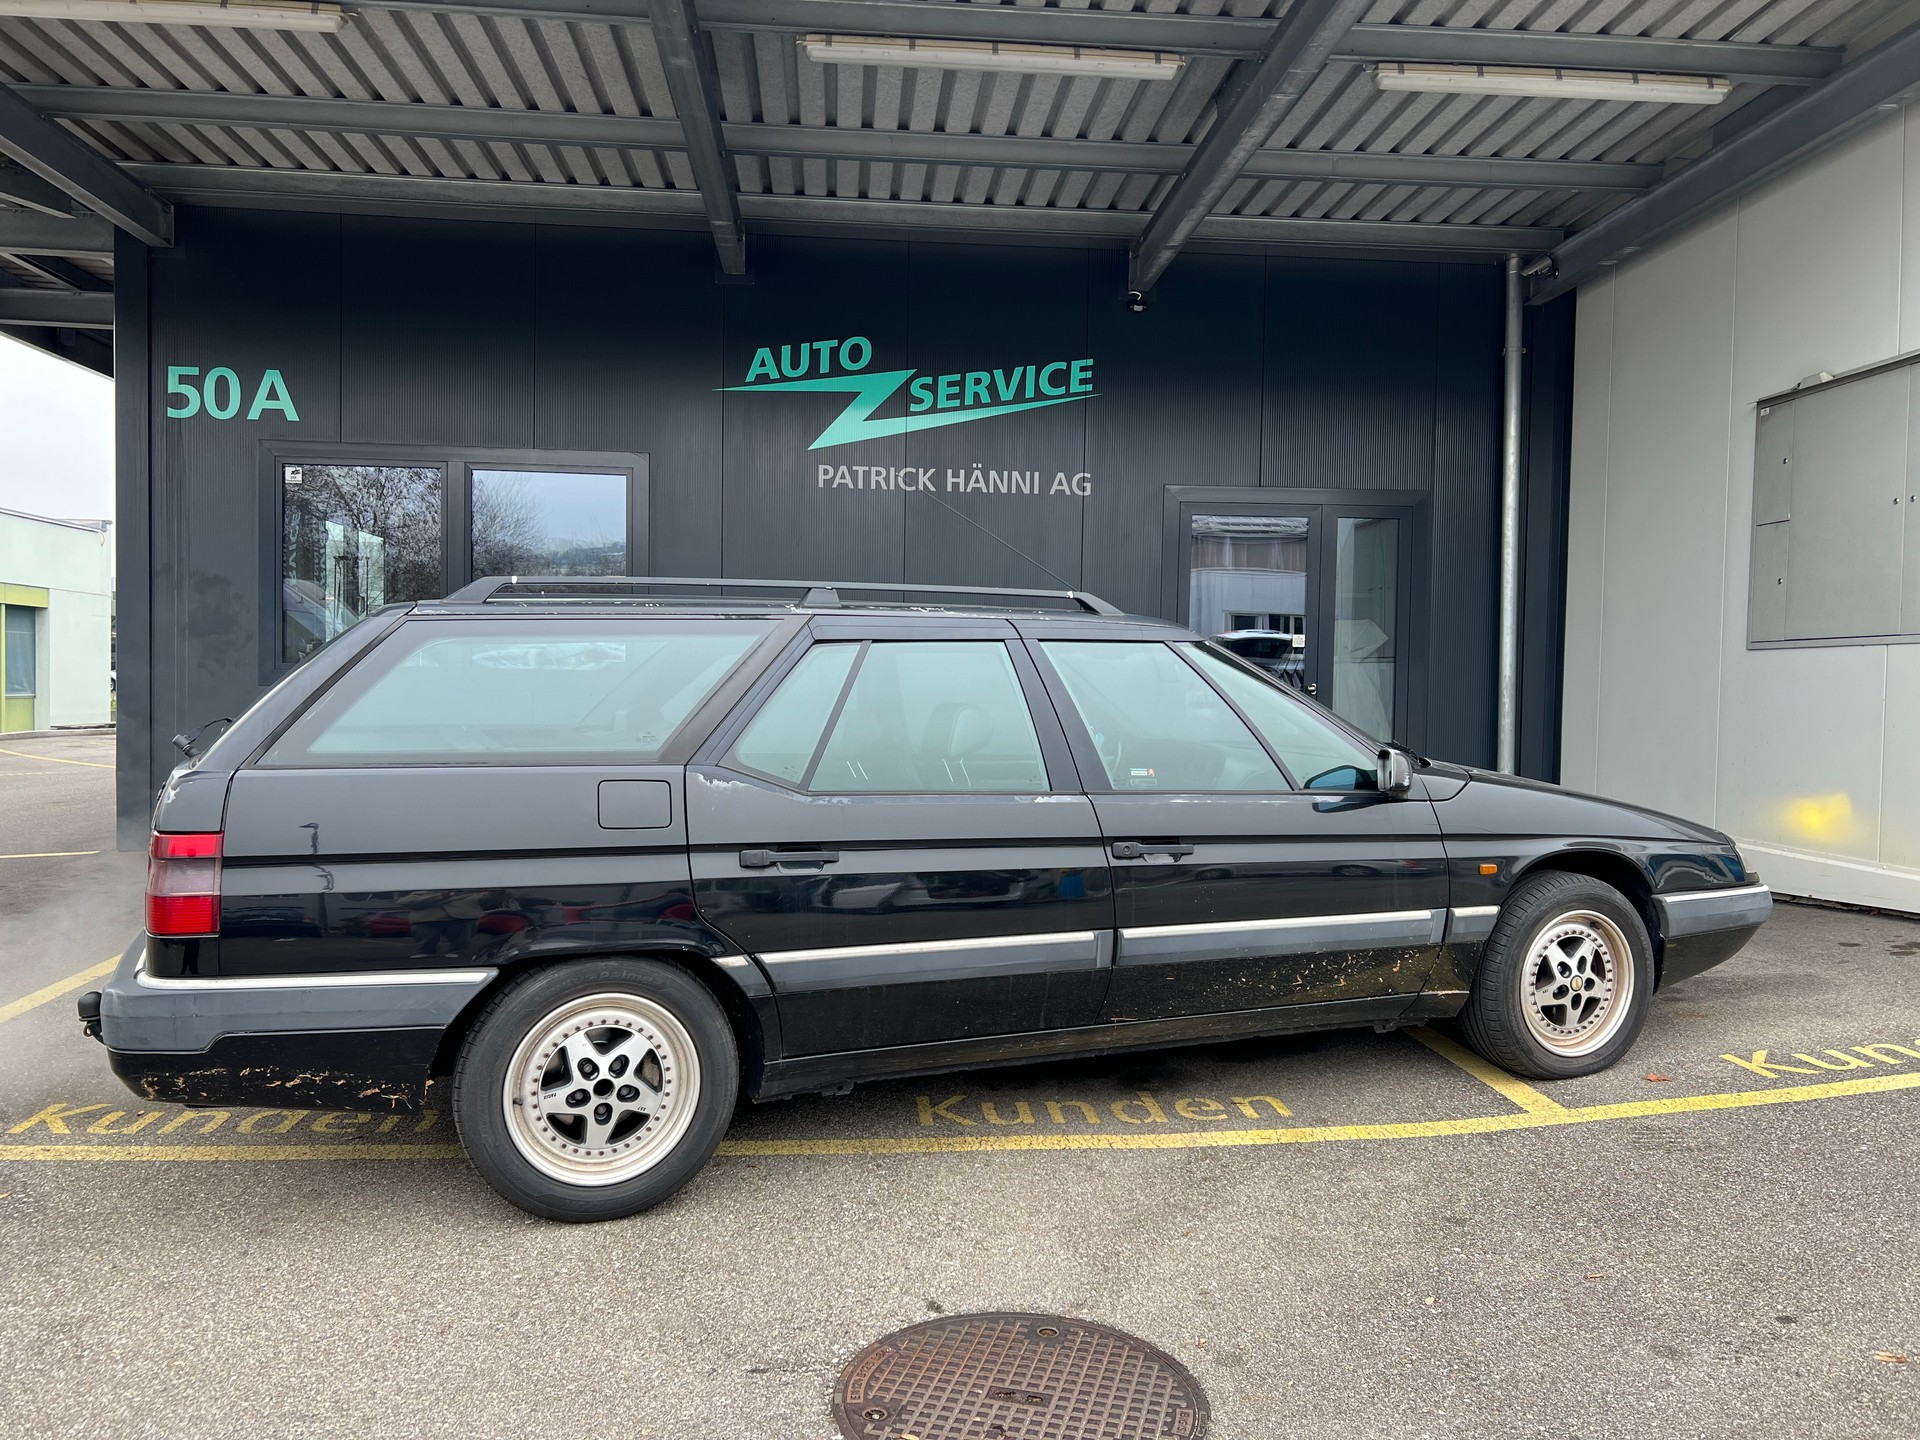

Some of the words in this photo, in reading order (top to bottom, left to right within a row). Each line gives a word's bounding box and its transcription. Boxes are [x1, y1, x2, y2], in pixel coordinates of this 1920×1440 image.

[746, 336, 873, 383] AUTO
[910, 358, 1094, 412] SERVICE
[818, 464, 937, 492] PATRICK
[947, 463, 1040, 495] HÄNNI
[1050, 472, 1092, 497] AG
[1718, 1038, 1919, 1078] Kun
[916, 1090, 1293, 1126] Kunden
